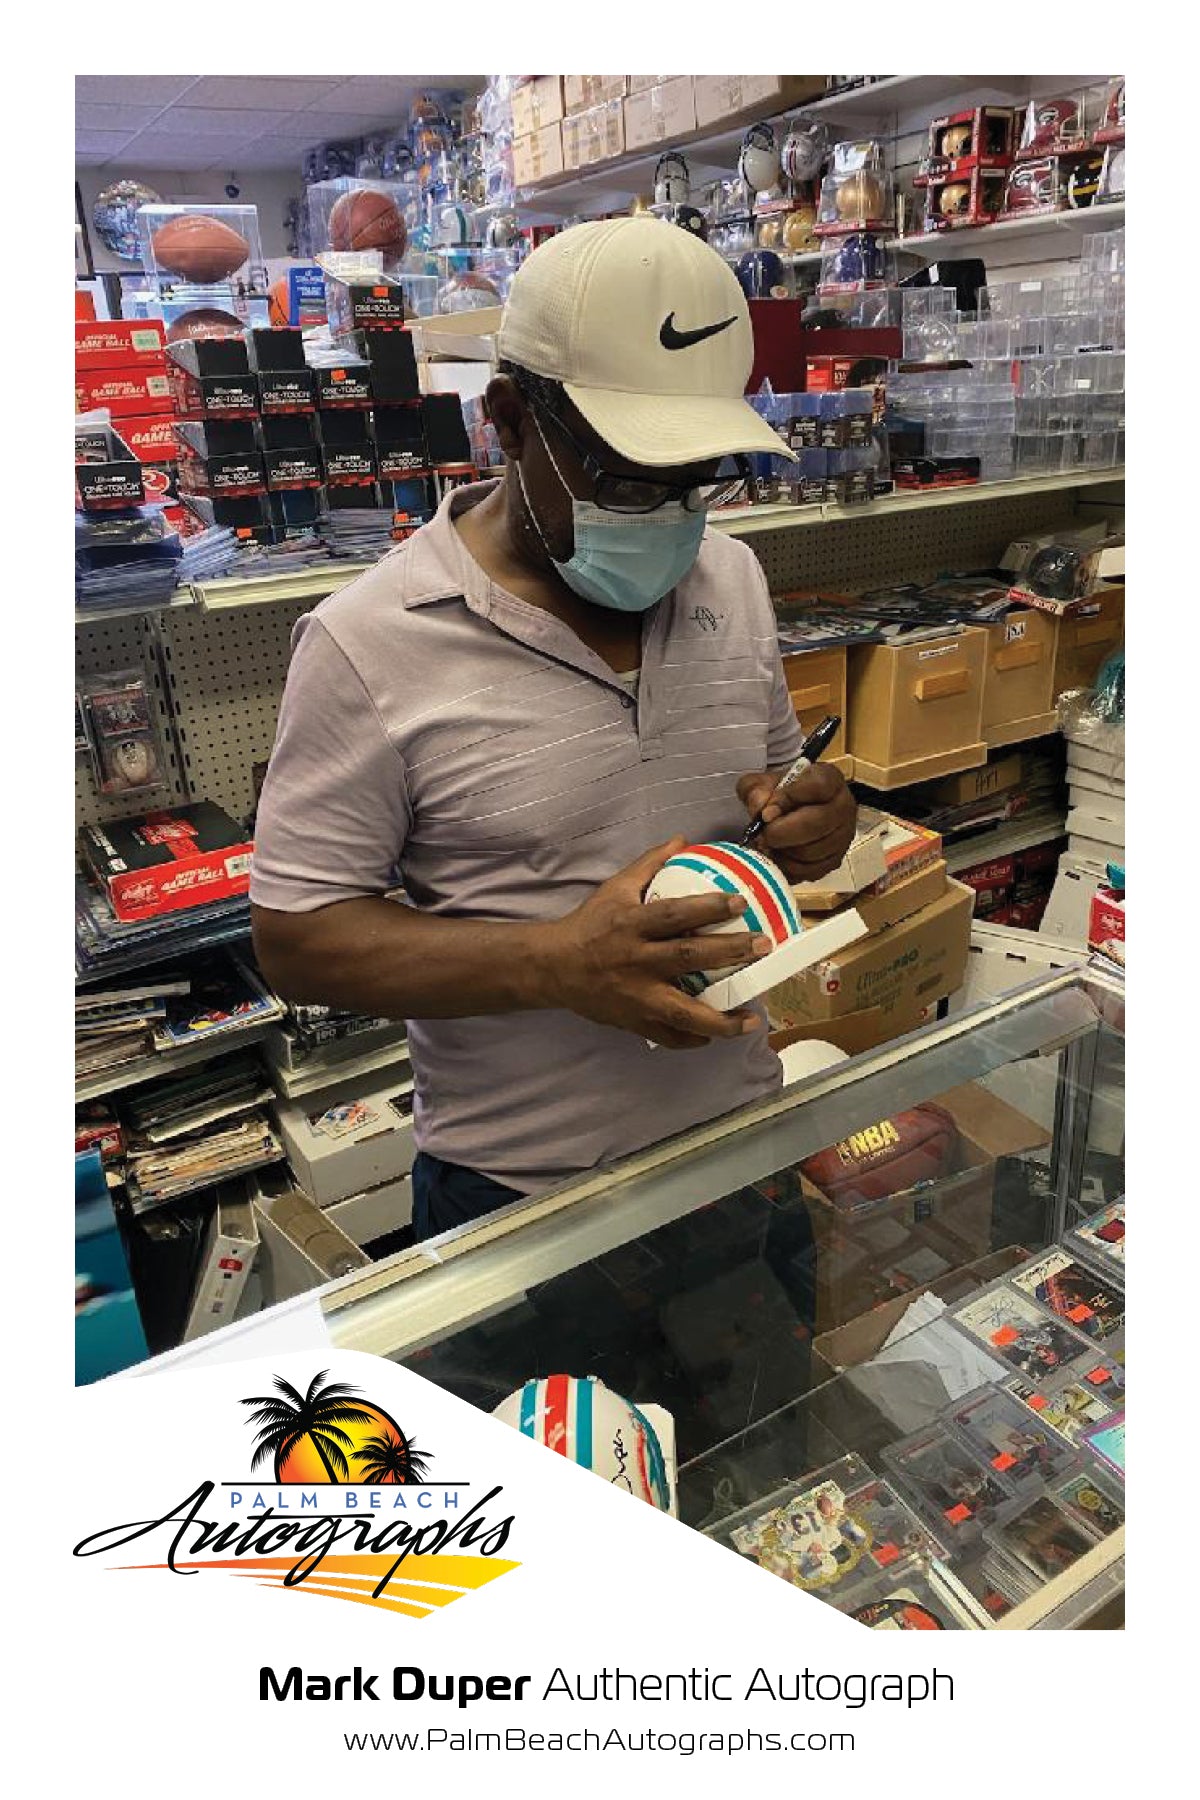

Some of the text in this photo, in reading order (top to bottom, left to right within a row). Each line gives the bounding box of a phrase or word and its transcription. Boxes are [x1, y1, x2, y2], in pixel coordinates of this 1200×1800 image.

[105, 338, 131, 347] BALL
[91, 387, 119, 398] GAME
[121, 385, 146, 395] BALL
[131, 431, 172, 444] GAME
[161, 868, 225, 891] GAME BALL
[848, 1120, 900, 1157] NBA
